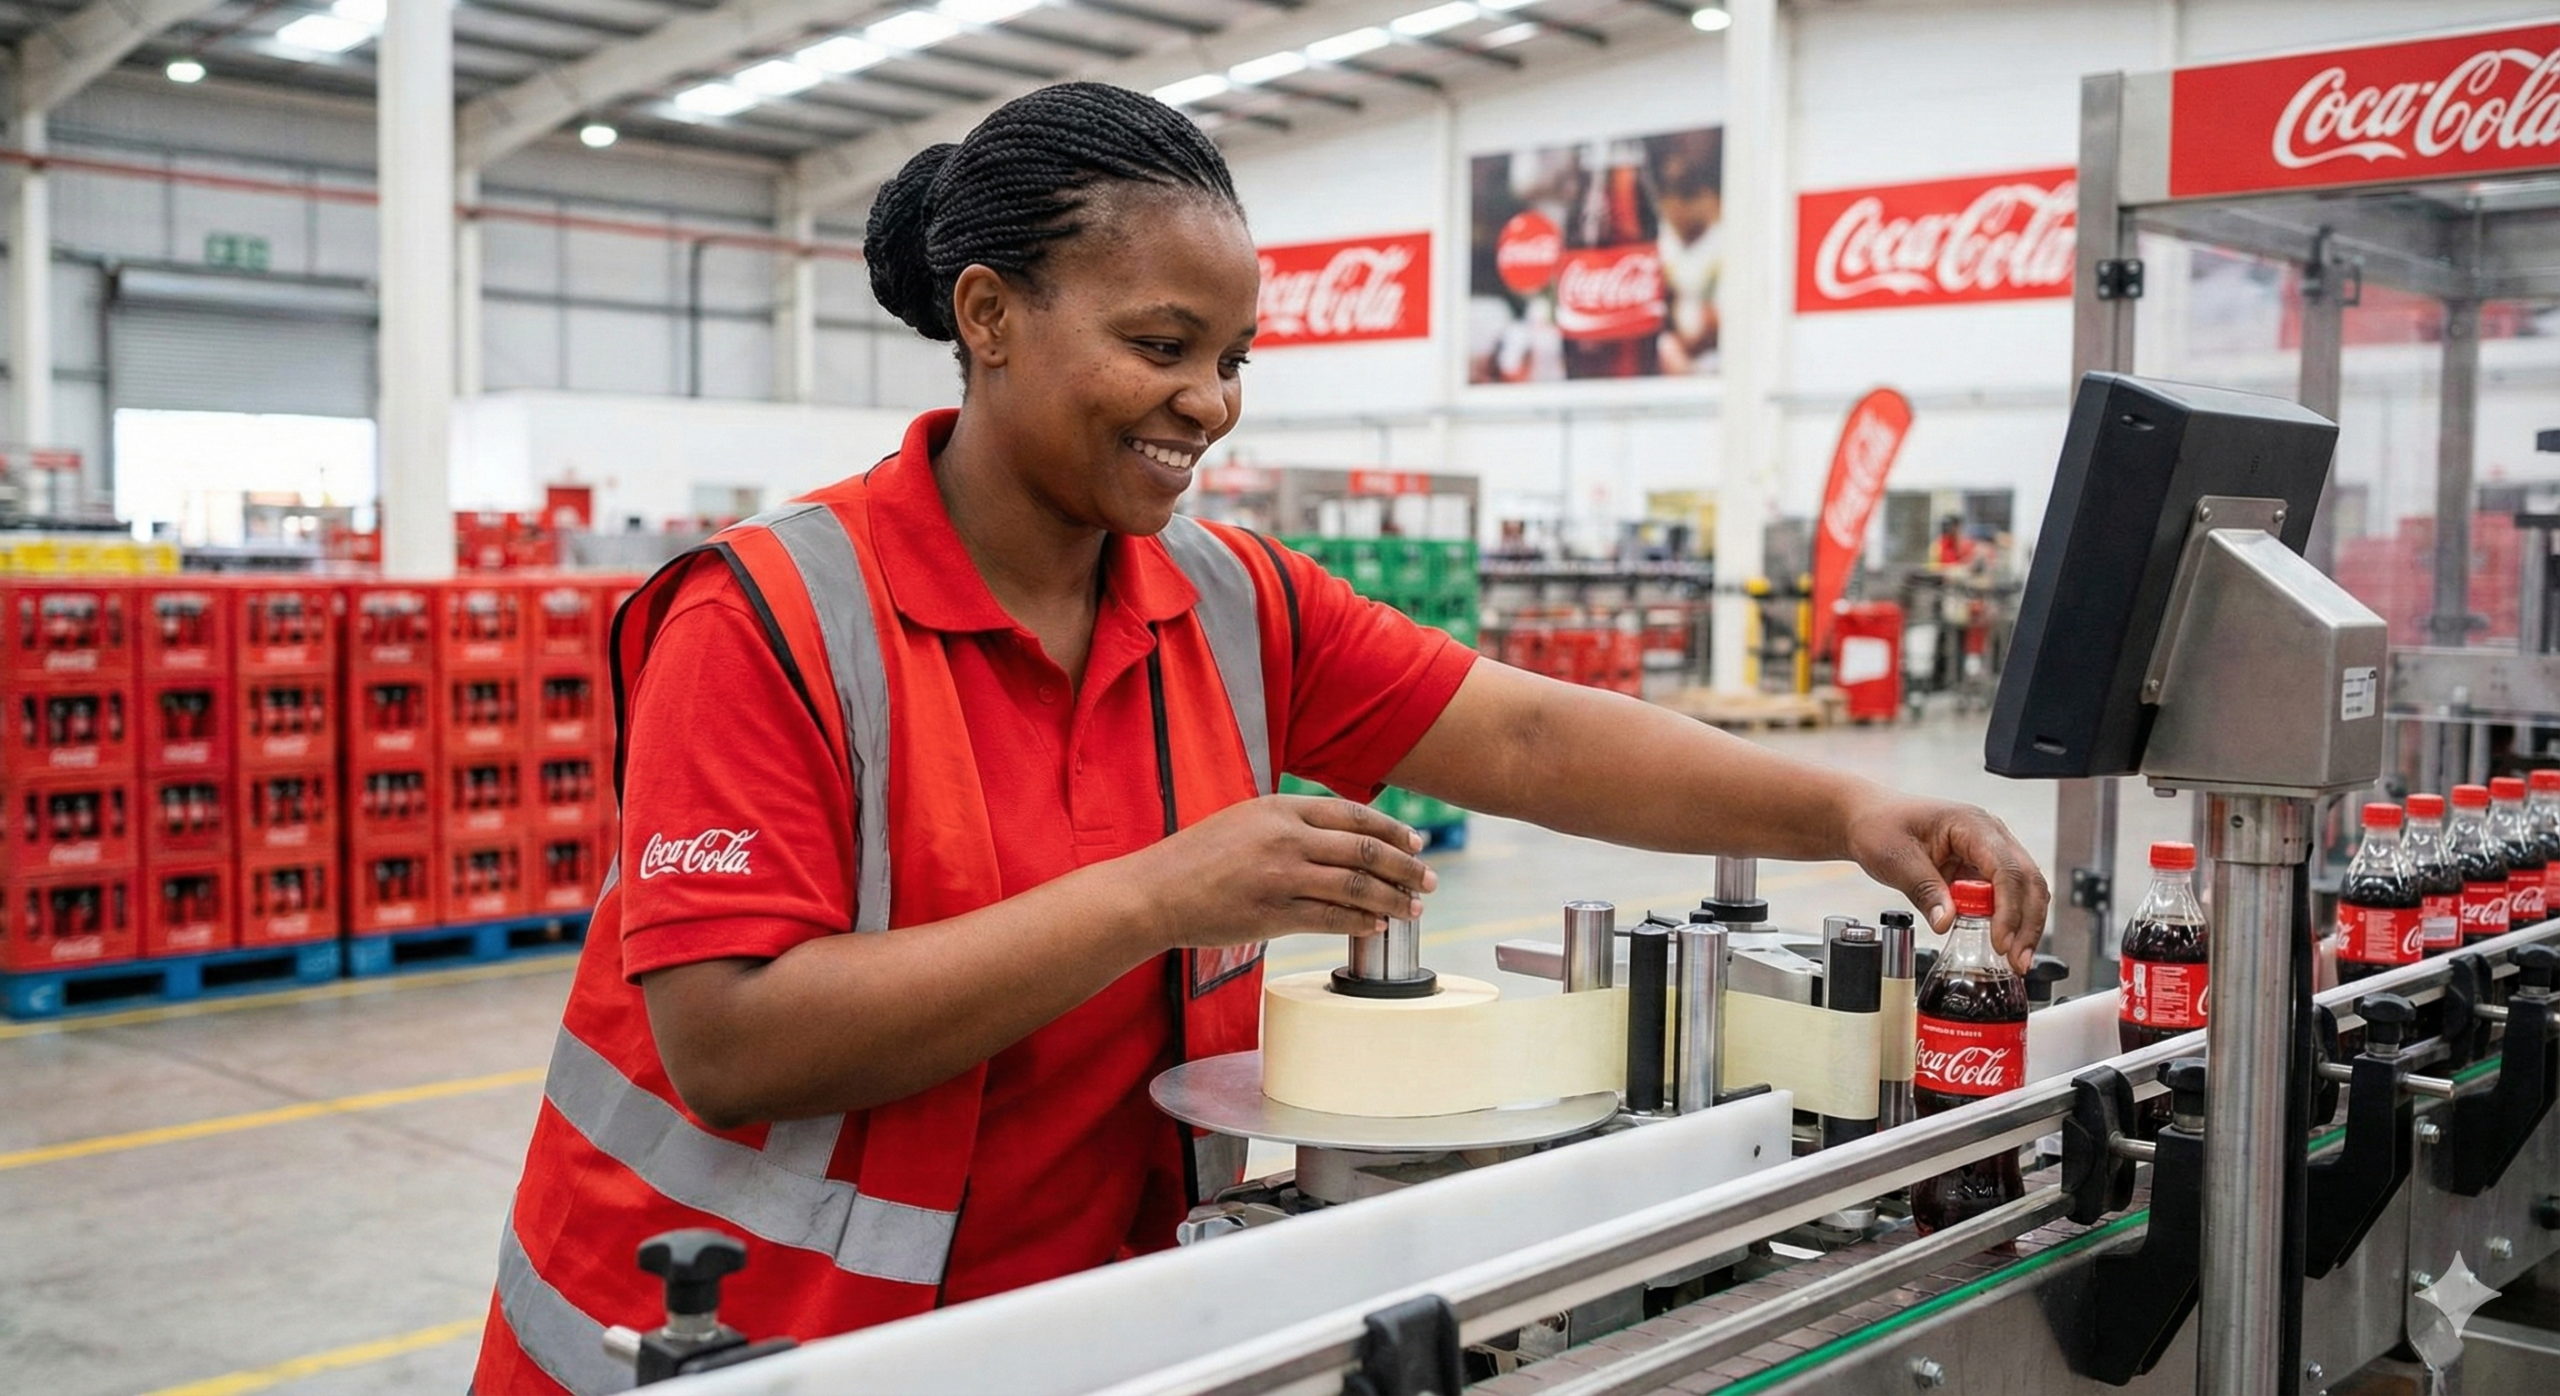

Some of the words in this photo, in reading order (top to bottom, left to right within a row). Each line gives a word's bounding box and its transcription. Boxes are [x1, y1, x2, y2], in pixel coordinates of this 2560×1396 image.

[2272, 48, 2560, 169] Coca-Cola
[1814, 180, 2077, 300] Coca-Cola
[640, 828, 760, 879] Coca-Cola
